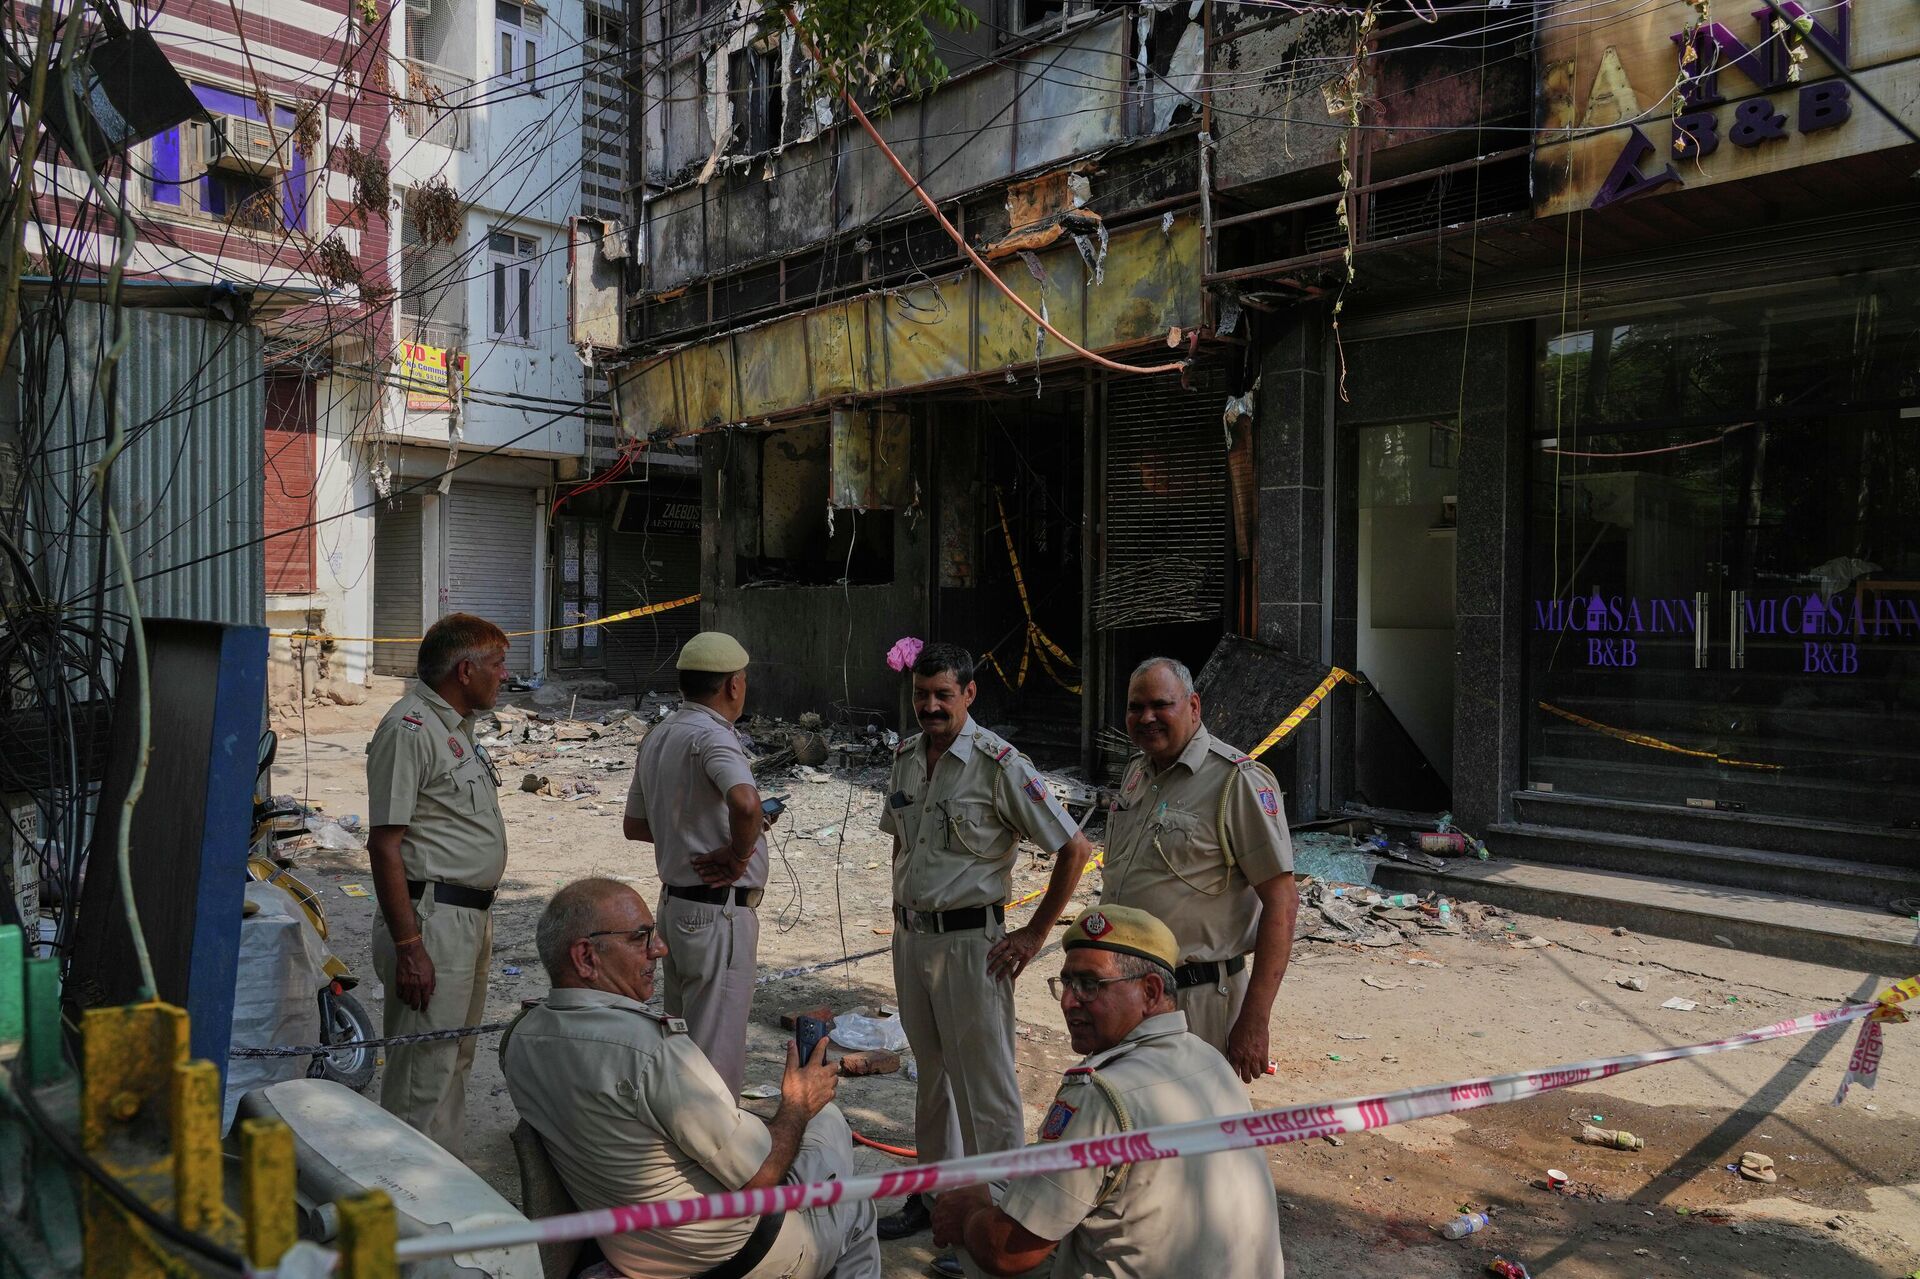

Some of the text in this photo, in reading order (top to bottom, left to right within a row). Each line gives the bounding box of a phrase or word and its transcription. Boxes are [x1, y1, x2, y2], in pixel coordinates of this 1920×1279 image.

[440, 351, 467, 371] LT
[1587, 638, 1637, 667] B&B
[1803, 641, 1859, 674] B&B
